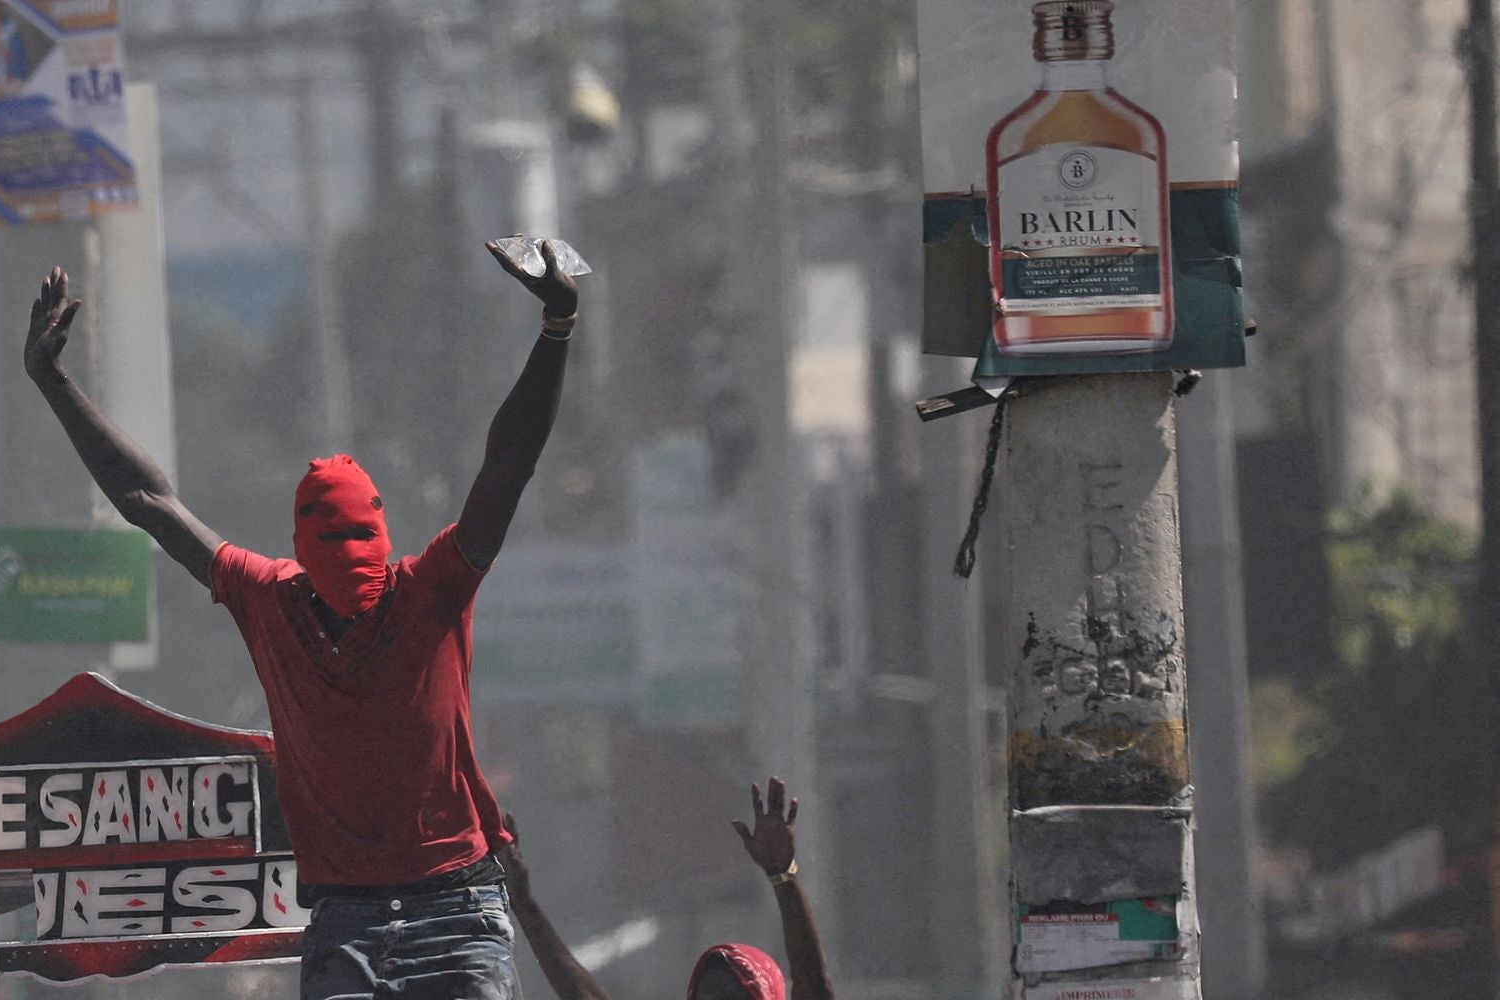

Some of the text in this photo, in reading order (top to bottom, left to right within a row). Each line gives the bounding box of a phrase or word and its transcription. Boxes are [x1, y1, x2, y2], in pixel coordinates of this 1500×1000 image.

[1019, 208, 1138, 235] BARLIN
[1060, 236, 1101, 247] RHUM
[1026, 256, 1135, 269] AGED IN OAK BARRELS
[40, 763, 254, 849] SANG
[1028, 913, 1069, 922] REKLAME
[1071, 913, 1093, 921] PRIM
[1060, 988, 1134, 1000] IMPRIMERIE
